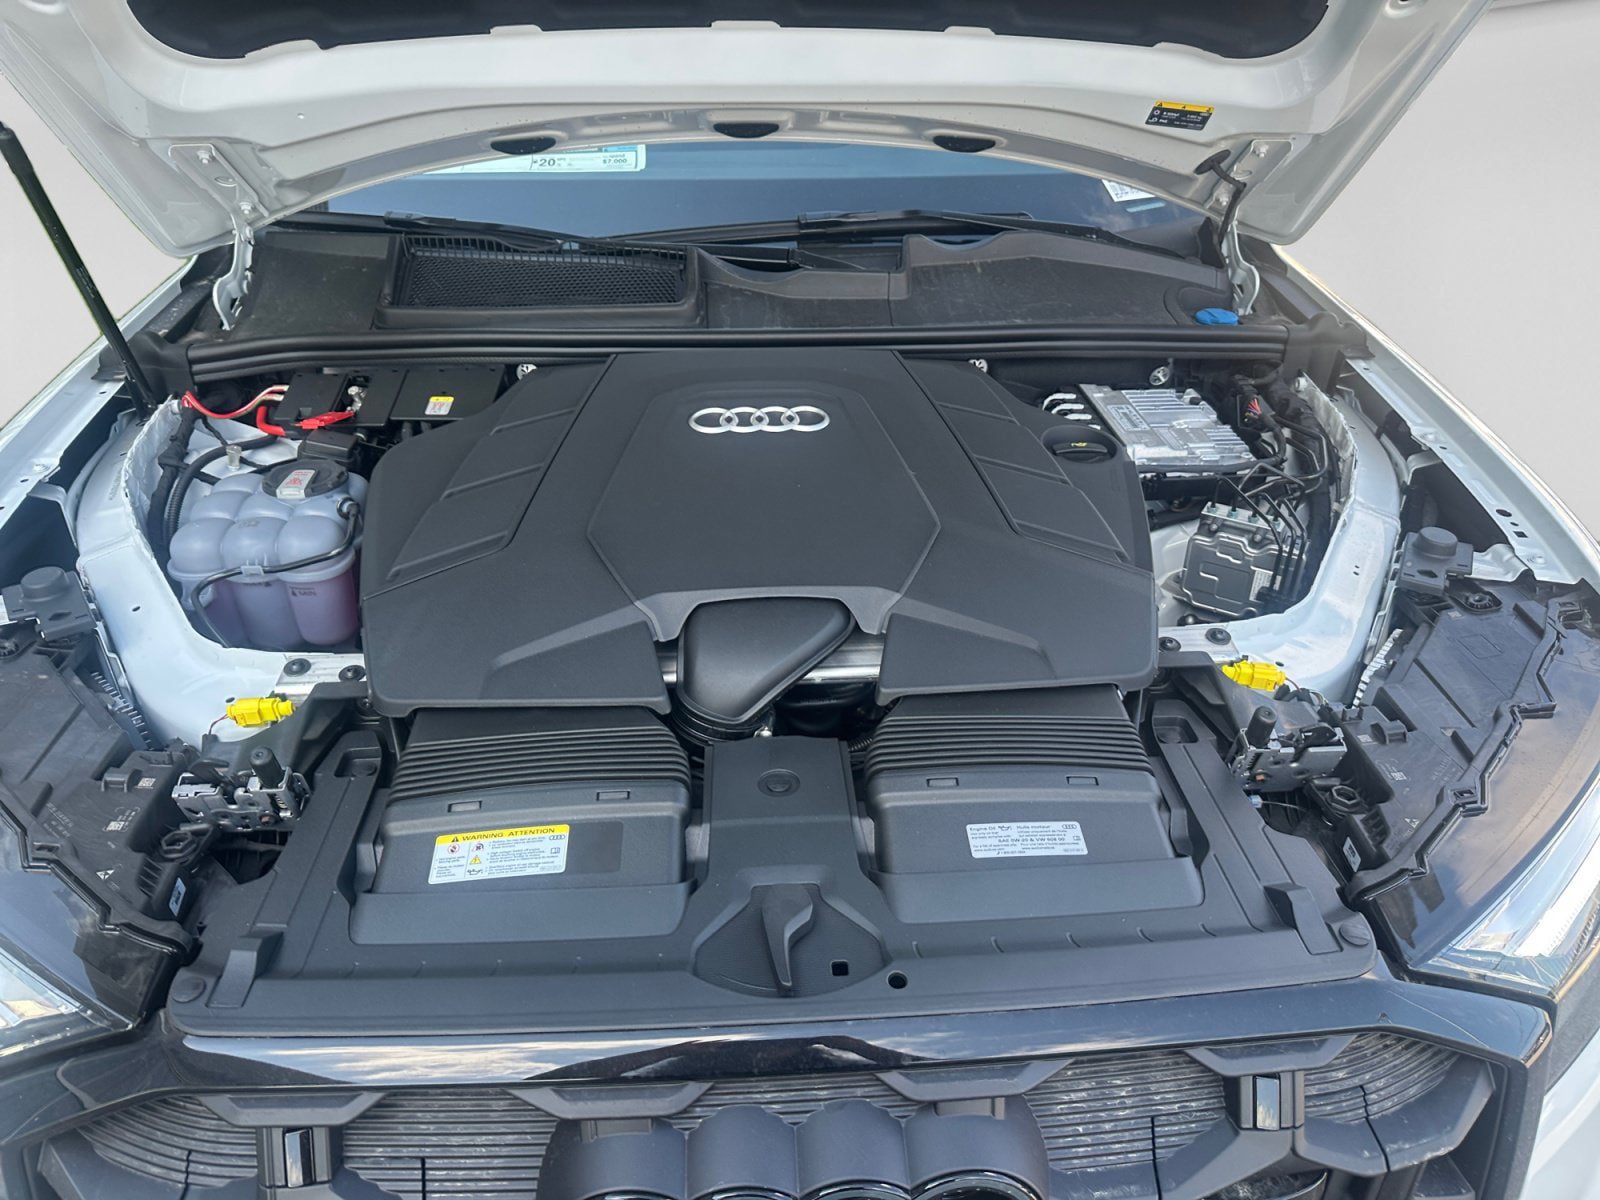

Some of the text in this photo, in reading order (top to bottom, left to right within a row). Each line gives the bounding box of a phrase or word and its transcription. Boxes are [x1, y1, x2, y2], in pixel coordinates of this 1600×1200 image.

[539, 158, 556, 167] 20
[462, 827, 556, 841] WARNING ATTENTION
